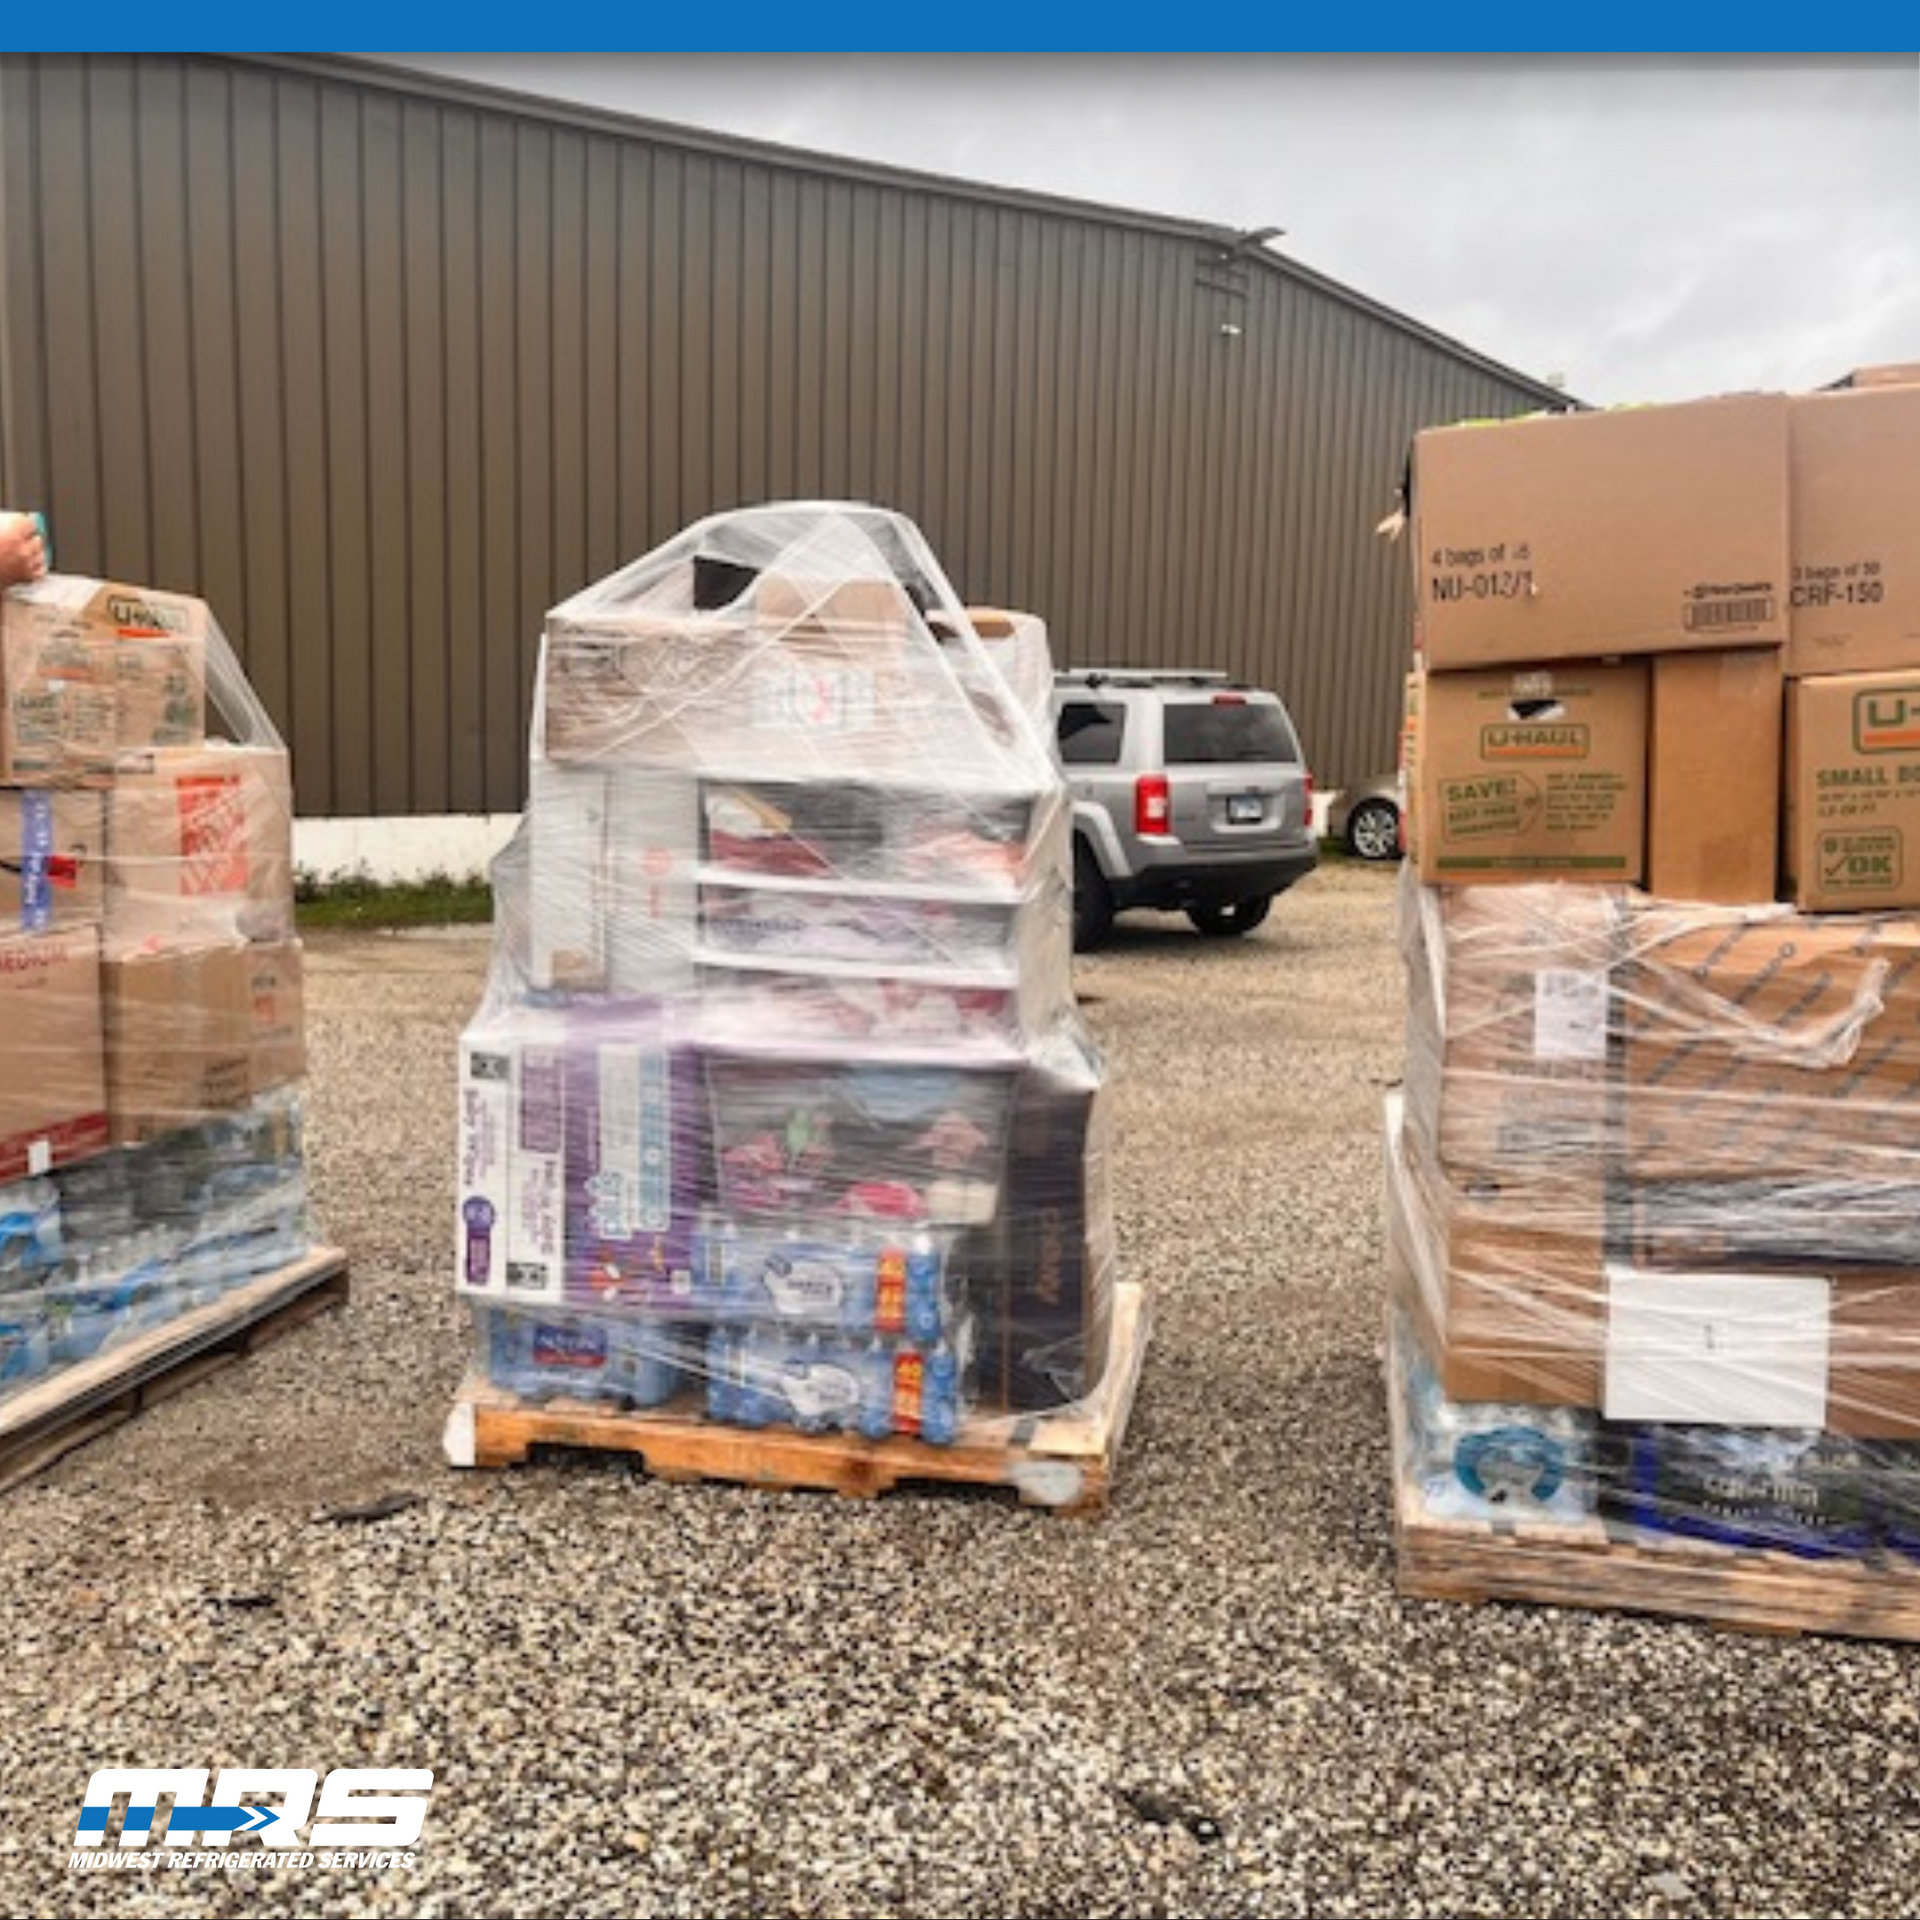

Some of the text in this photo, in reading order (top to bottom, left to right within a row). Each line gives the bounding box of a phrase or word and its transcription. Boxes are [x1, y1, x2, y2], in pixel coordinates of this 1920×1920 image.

[1446, 549, 1485, 568] bags
[1489, 543, 1505, 561] of
[1487, 729, 1581, 747] U-HAUL
[1816, 766, 1887, 788] SMALL
[1446, 777, 1518, 802] SAVE!
[1847, 855, 1892, 874] OK
